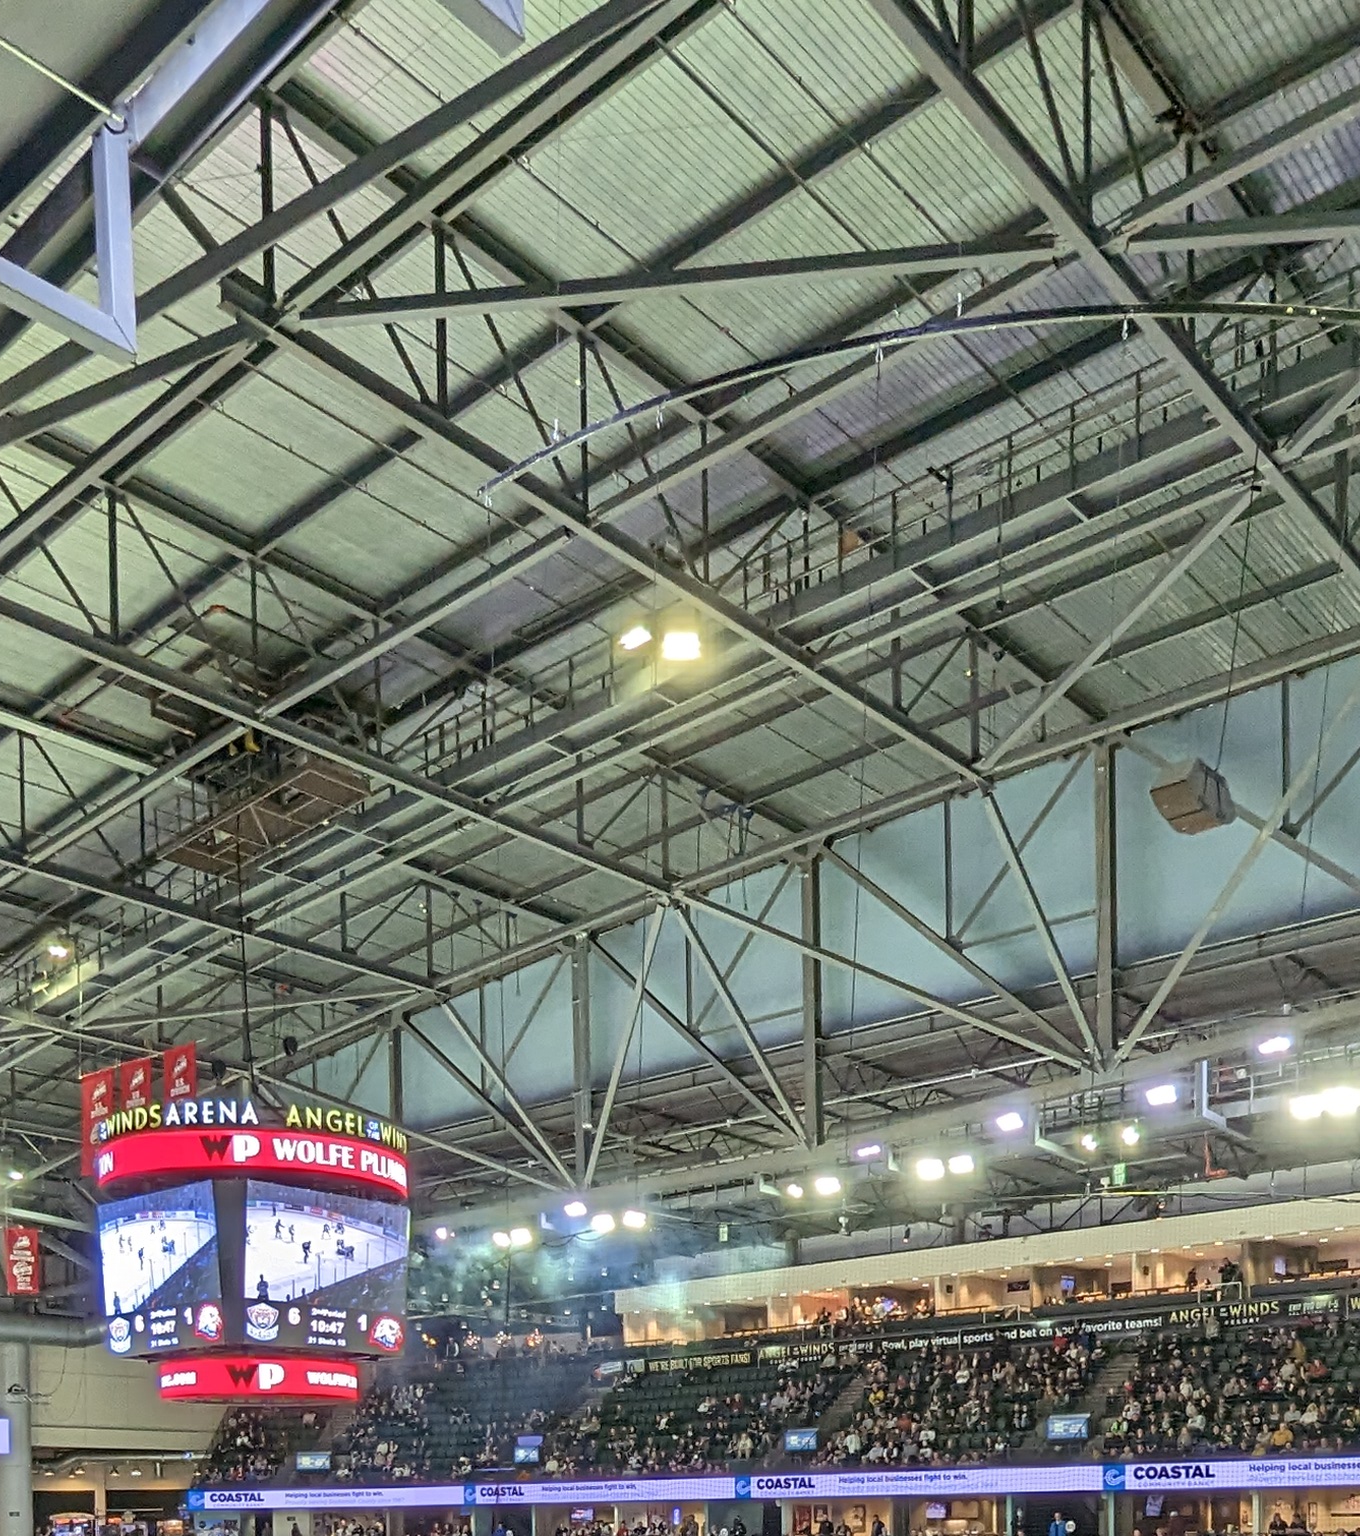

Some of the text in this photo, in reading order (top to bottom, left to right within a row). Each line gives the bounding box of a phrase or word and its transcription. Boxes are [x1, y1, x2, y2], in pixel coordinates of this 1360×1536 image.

[105, 1103, 162, 1141] WINDS
[165, 1100, 259, 1126] ARENA
[286, 1104, 367, 1139] ANGEL
[272, 1138, 356, 1169] WOLFE
[288, 1307, 301, 1326] 6
[1169, 1301, 1280, 1323] ANGEL WINDS
[310, 1321, 345, 1335] 10:47
[357, 1315, 368, 1331] 1
[930, 1334, 960, 1347] virtual
[963, 1331, 993, 1344] sports
[1019, 1326, 1037, 1339] bet
[1040, 1327, 1053, 1337] on
[1124, 1316, 1163, 1331] teams!
[800, 1342, 835, 1355] WINDS
[1133, 1465, 1215, 1481] COASTAL
[1249, 1463, 1285, 1473] Helping
[1288, 1463, 1311, 1472] local
[757, 1477, 815, 1490] COASTAL
[867, 1475, 883, 1483] local
[924, 1474, 941, 1483] fight
[210, 1492, 265, 1503] COASTAL
[480, 1486, 524, 1498] COASTAL
